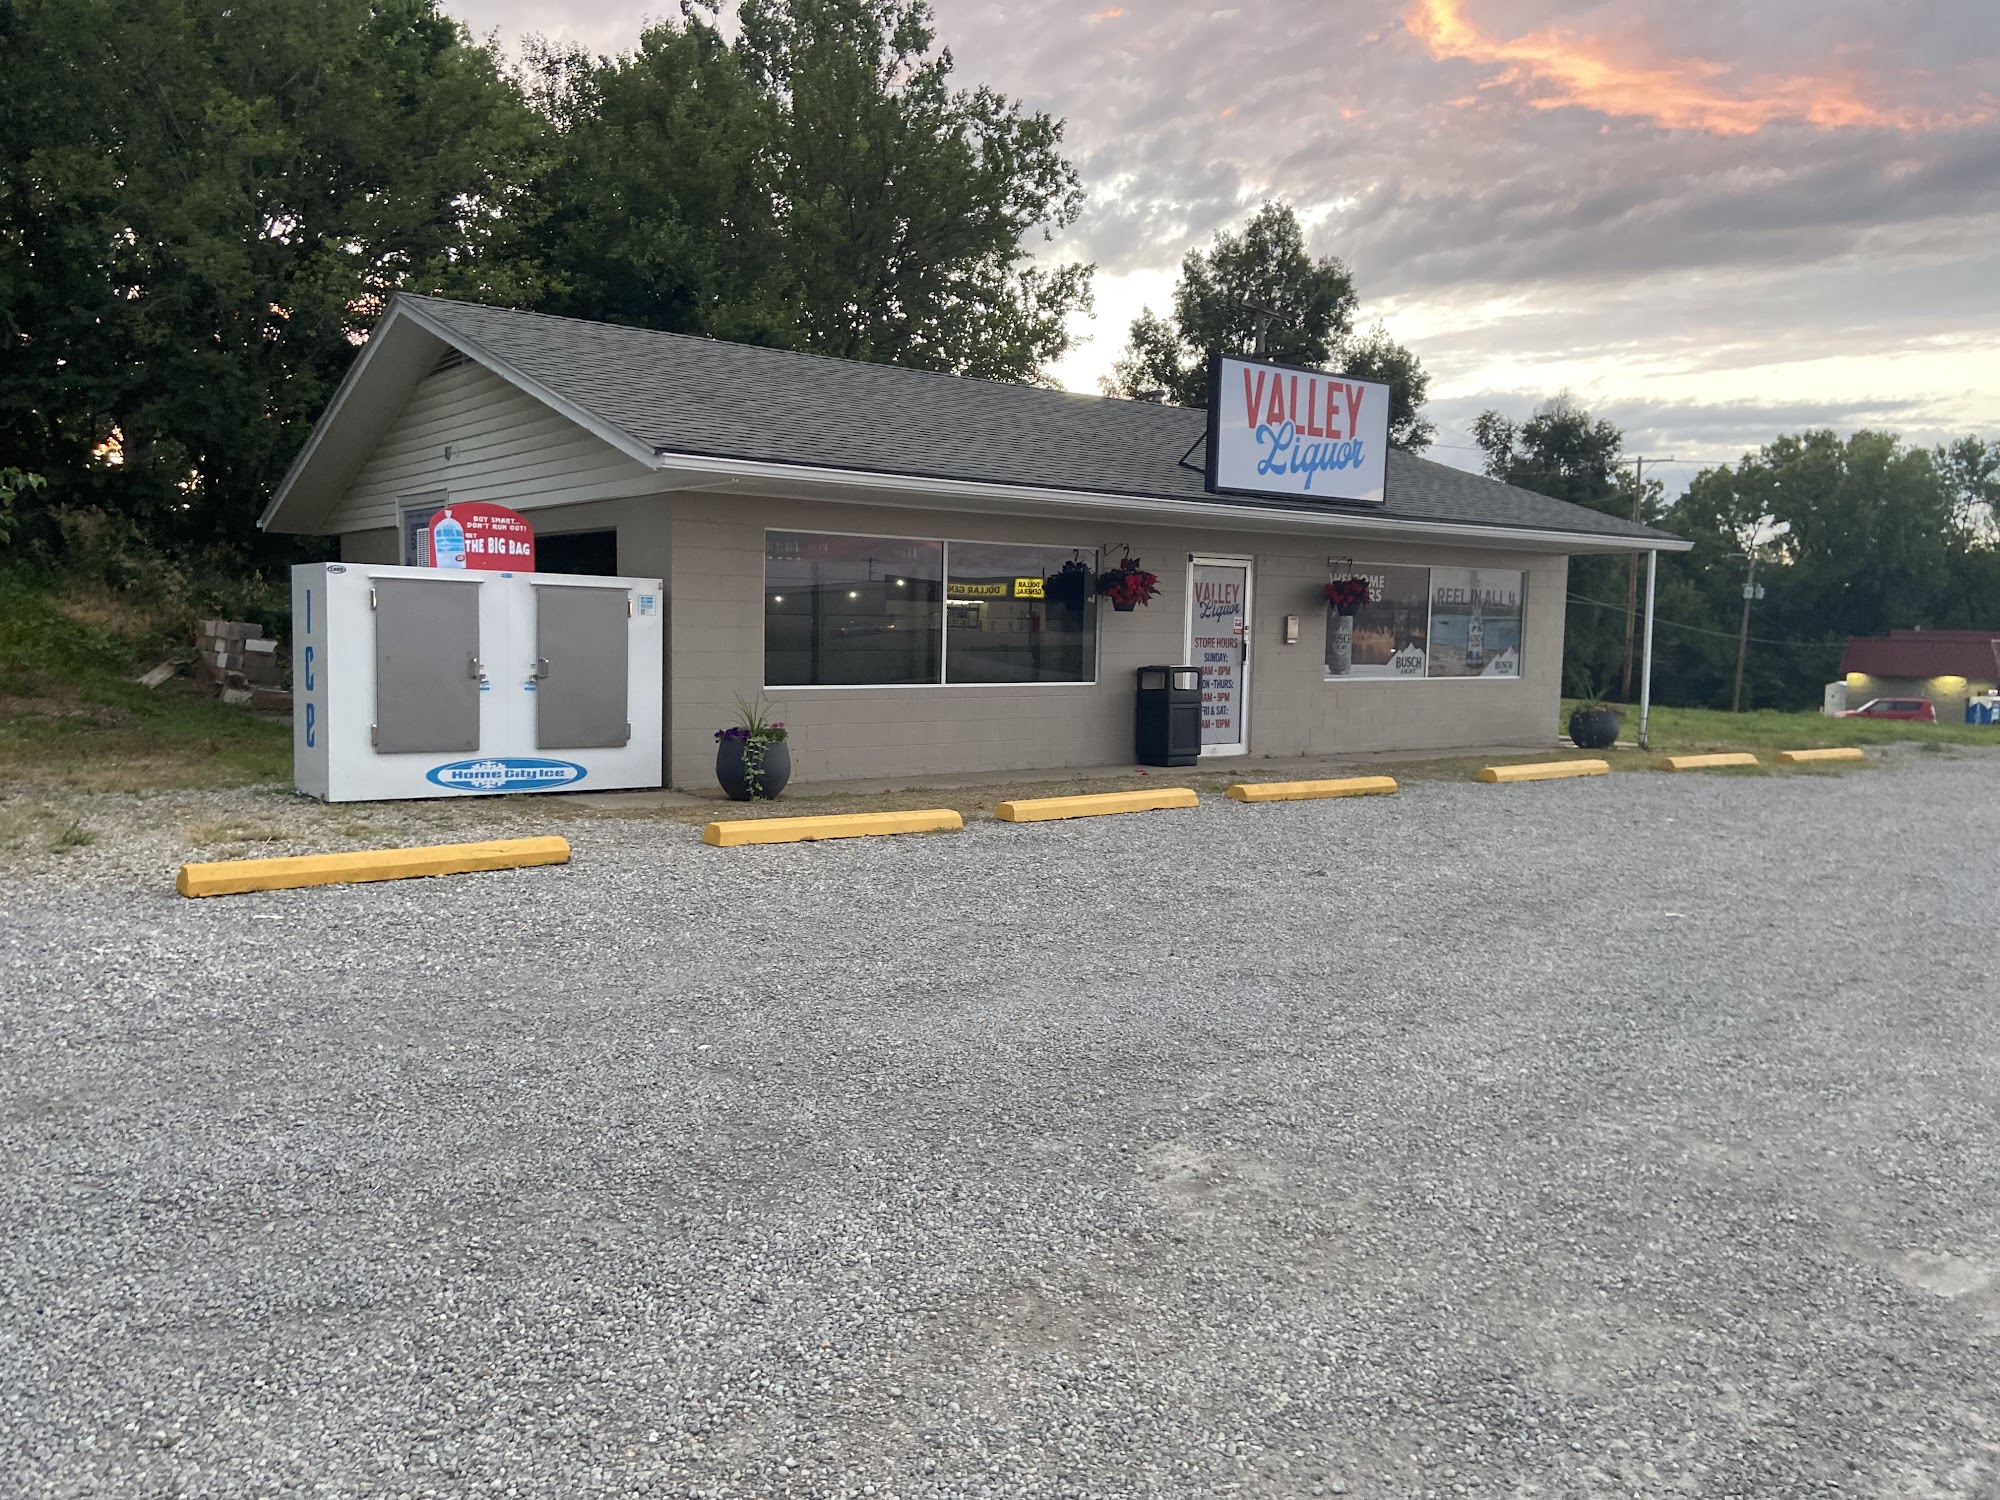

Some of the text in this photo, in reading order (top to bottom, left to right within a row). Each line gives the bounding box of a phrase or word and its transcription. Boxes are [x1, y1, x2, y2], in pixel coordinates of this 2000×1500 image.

[1243, 368, 1364, 440] VALLEY
[1255, 420, 1366, 490] Liquor
[492, 523, 507, 531] RUN
[509, 524, 527, 532] OUT!
[464, 537, 531, 556] THE BIG BAG
[1195, 582, 1240, 604] VALLEY
[1437, 587, 1467, 606] REEL
[1470, 589, 1482, 606] IN
[1484, 590, 1506, 607] ALL
[1199, 599, 1240, 623] Liquor
[1194, 637, 1238, 648] STORE HOURS
[1204, 653, 1229, 662] SUNDAY:
[1396, 656, 1422, 669] BUSCH
[1494, 660, 1514, 670] BUSCH
[1201, 680, 1210, 689] ON
[1210, 706, 1215, 716] &
[1216, 705, 1229, 716] SAT:
[1201, 719, 1210, 729] AM
[451, 769, 565, 779] Home City Ice
